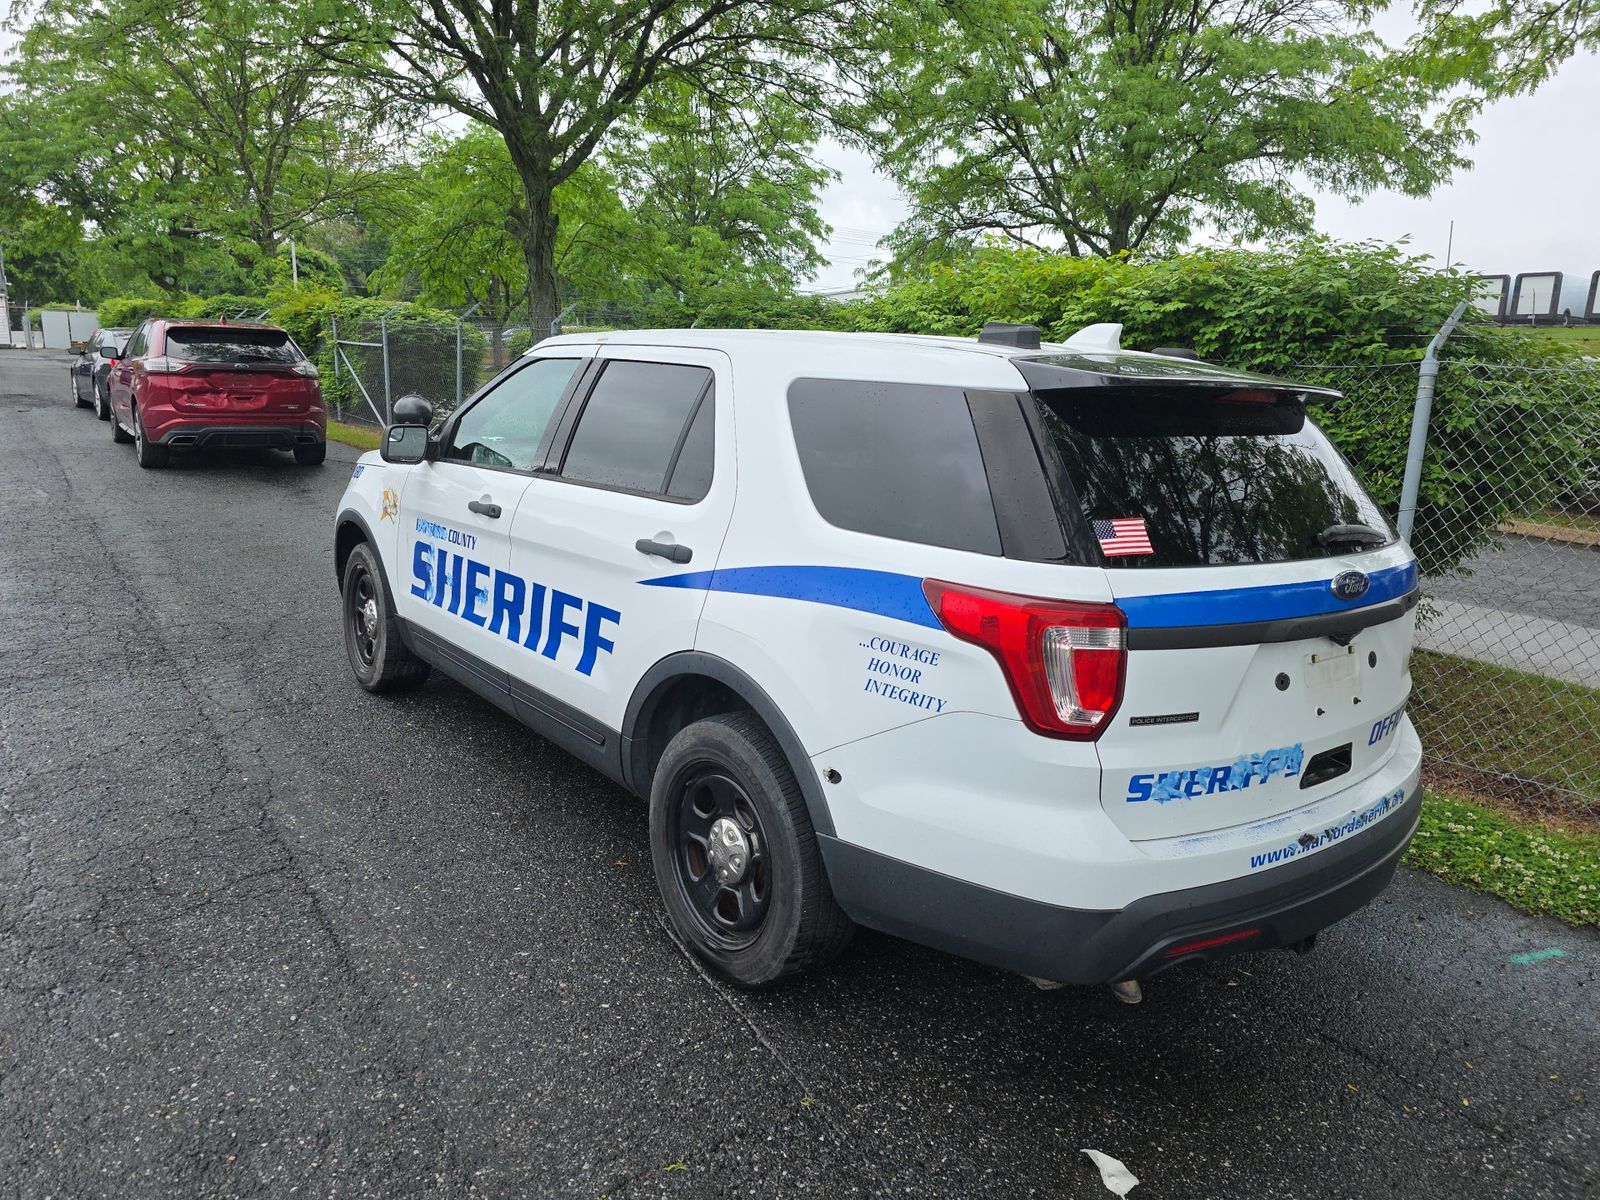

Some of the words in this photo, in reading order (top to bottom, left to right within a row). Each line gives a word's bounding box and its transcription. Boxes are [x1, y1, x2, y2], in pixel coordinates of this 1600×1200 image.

[447, 528, 478, 550] COUNTY
[410, 540, 622, 677] SHERIFF
[867, 657, 922, 684] HONOR
[864, 678, 947, 713] INTEGRITY
[1155, 714, 1198, 724] INTERCEPTOR
